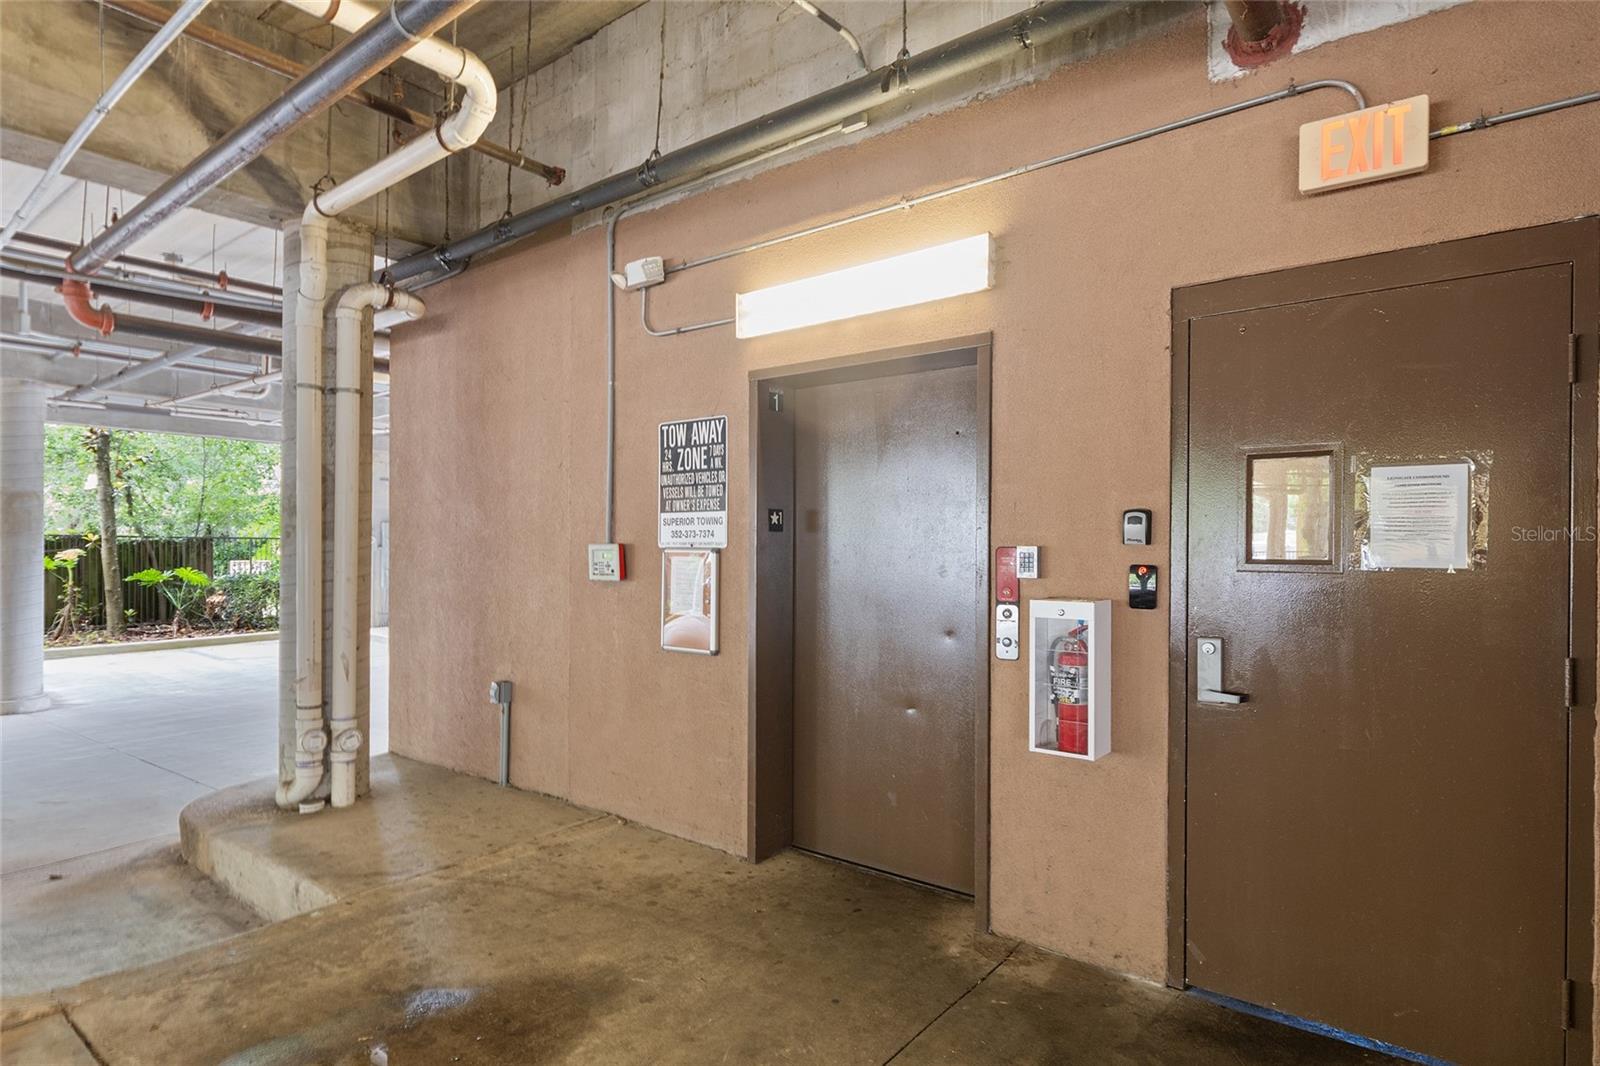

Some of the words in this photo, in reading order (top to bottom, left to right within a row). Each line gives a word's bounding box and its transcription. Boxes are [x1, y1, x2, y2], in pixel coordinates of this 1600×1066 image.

[1320, 104, 1412, 181] EXIT
[773, 394, 779, 411] 1
[661, 423, 687, 448] TOW
[691, 419, 725, 446] AWAY
[664, 449, 672, 461] 24
[677, 446, 708, 471] ZONE
[695, 470, 718, 485] VEHICLES
[718, 470, 726, 483] OR
[662, 486, 684, 499] VESSELS
[684, 485, 696, 498] WILL
[697, 485, 705, 497] BE
[705, 483, 724, 497] TOWED
[665, 500, 672, 511] AT
[696, 498, 721, 511] EXPENSE
[662, 517, 696, 526] SUPERIOR
[696, 516, 724, 525] TOWING
[670, 530, 715, 539] 352-373-7374
[1053, 677, 1072, 687] FIRE
